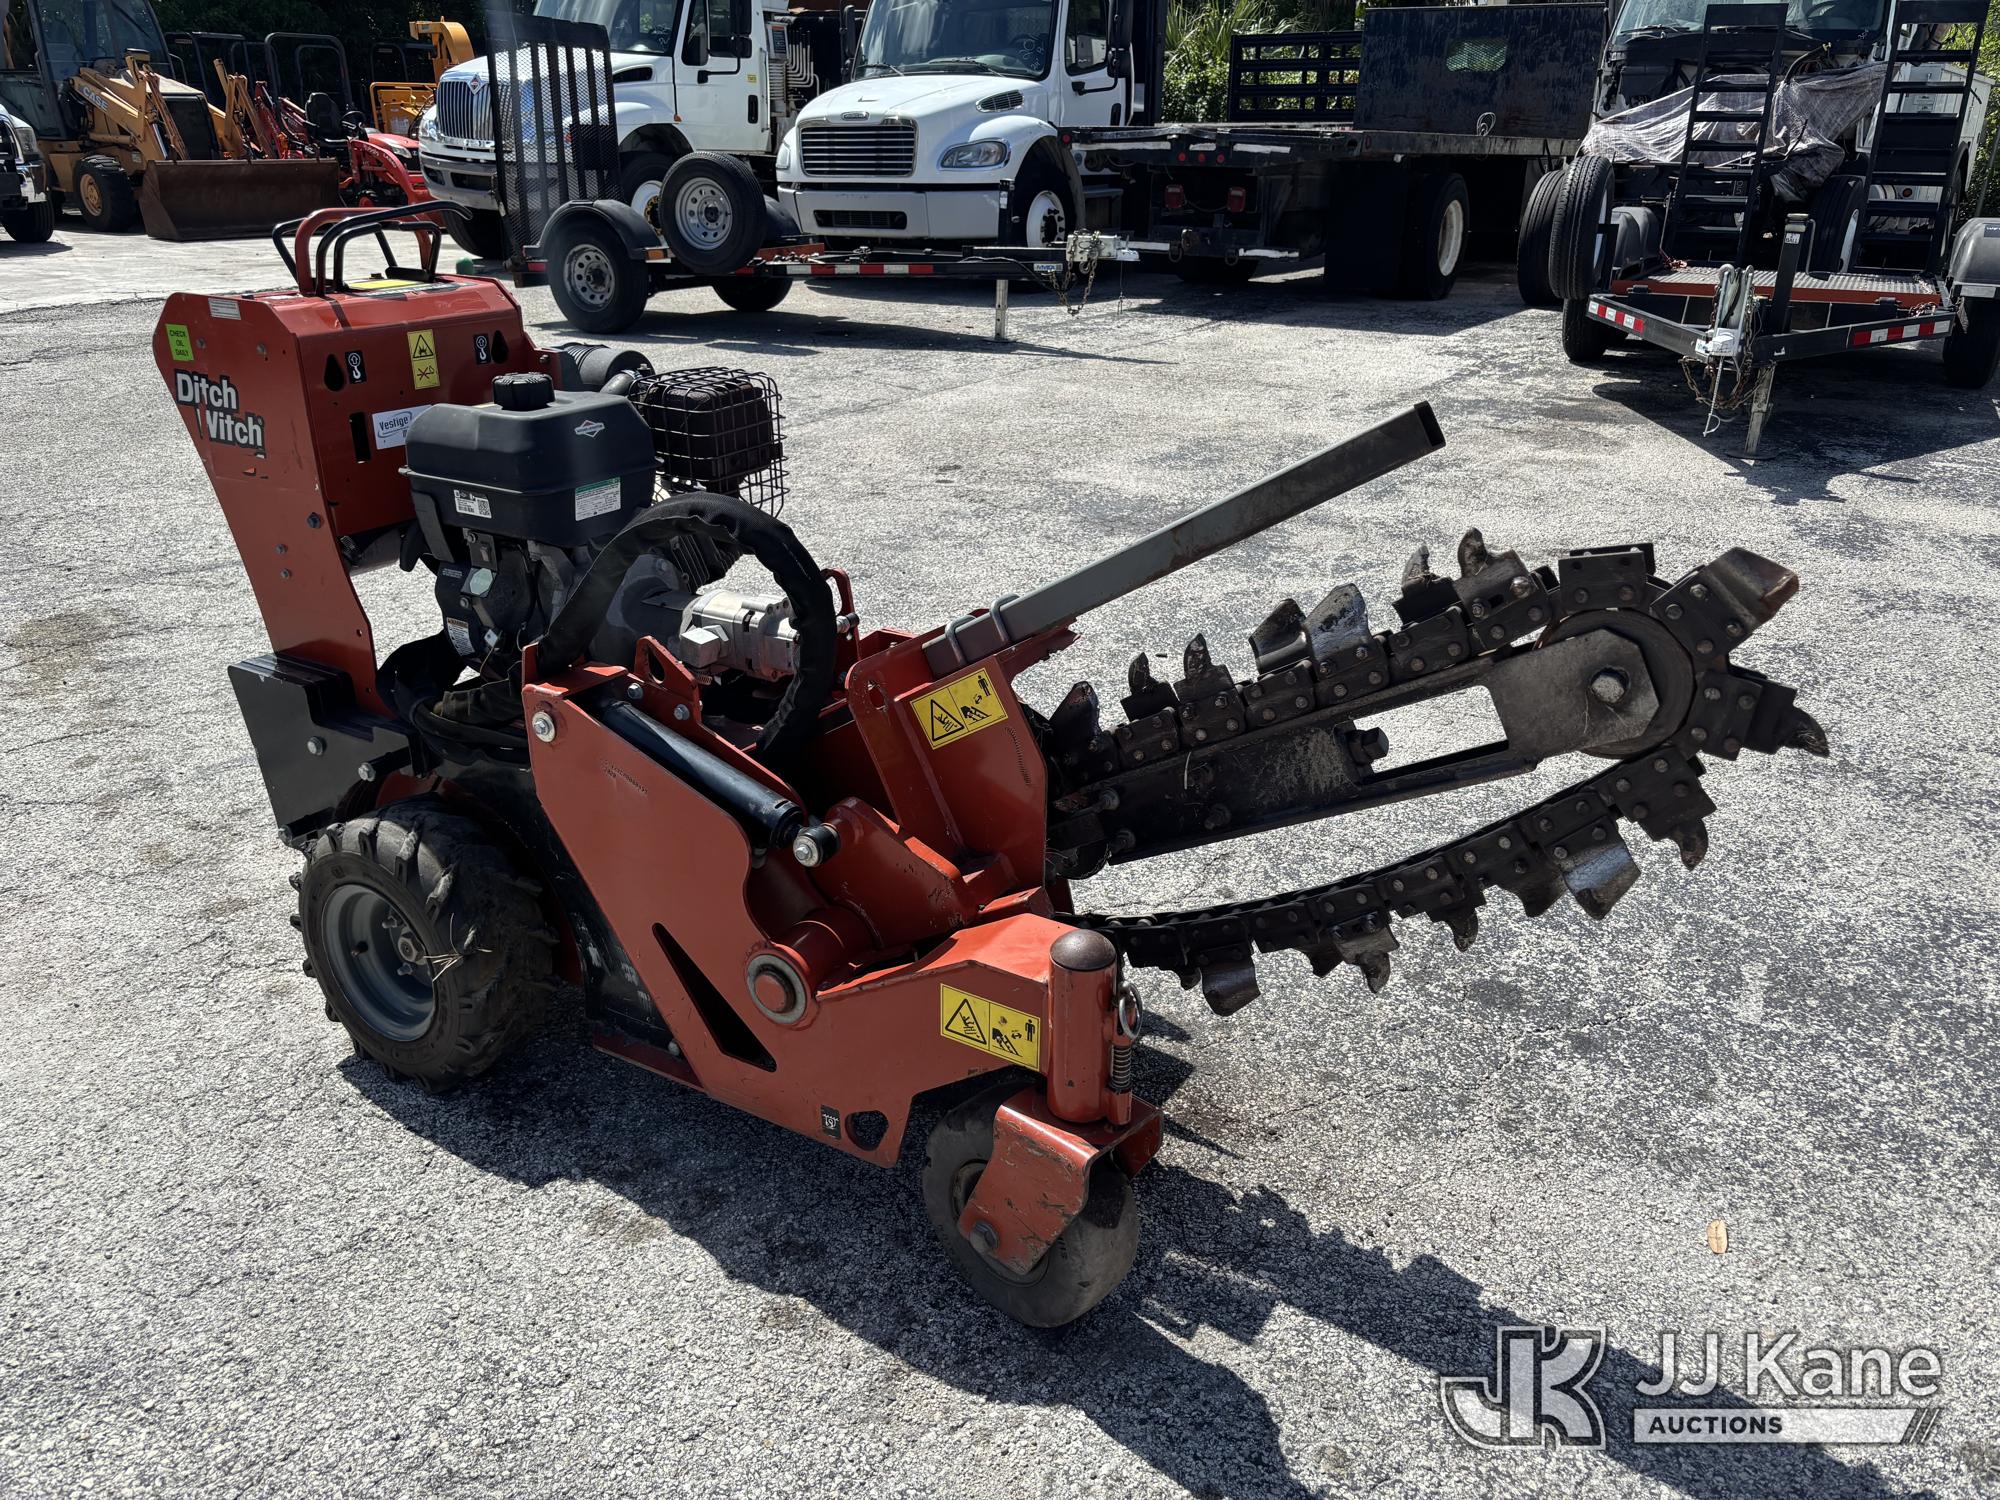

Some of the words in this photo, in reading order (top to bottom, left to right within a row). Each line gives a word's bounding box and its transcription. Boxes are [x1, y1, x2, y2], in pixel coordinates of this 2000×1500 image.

[83, 86, 109, 111] CASE
[169, 329, 188, 338] CHECK
[176, 372, 238, 410] Ditch
[379, 416, 409, 431] Vestige
